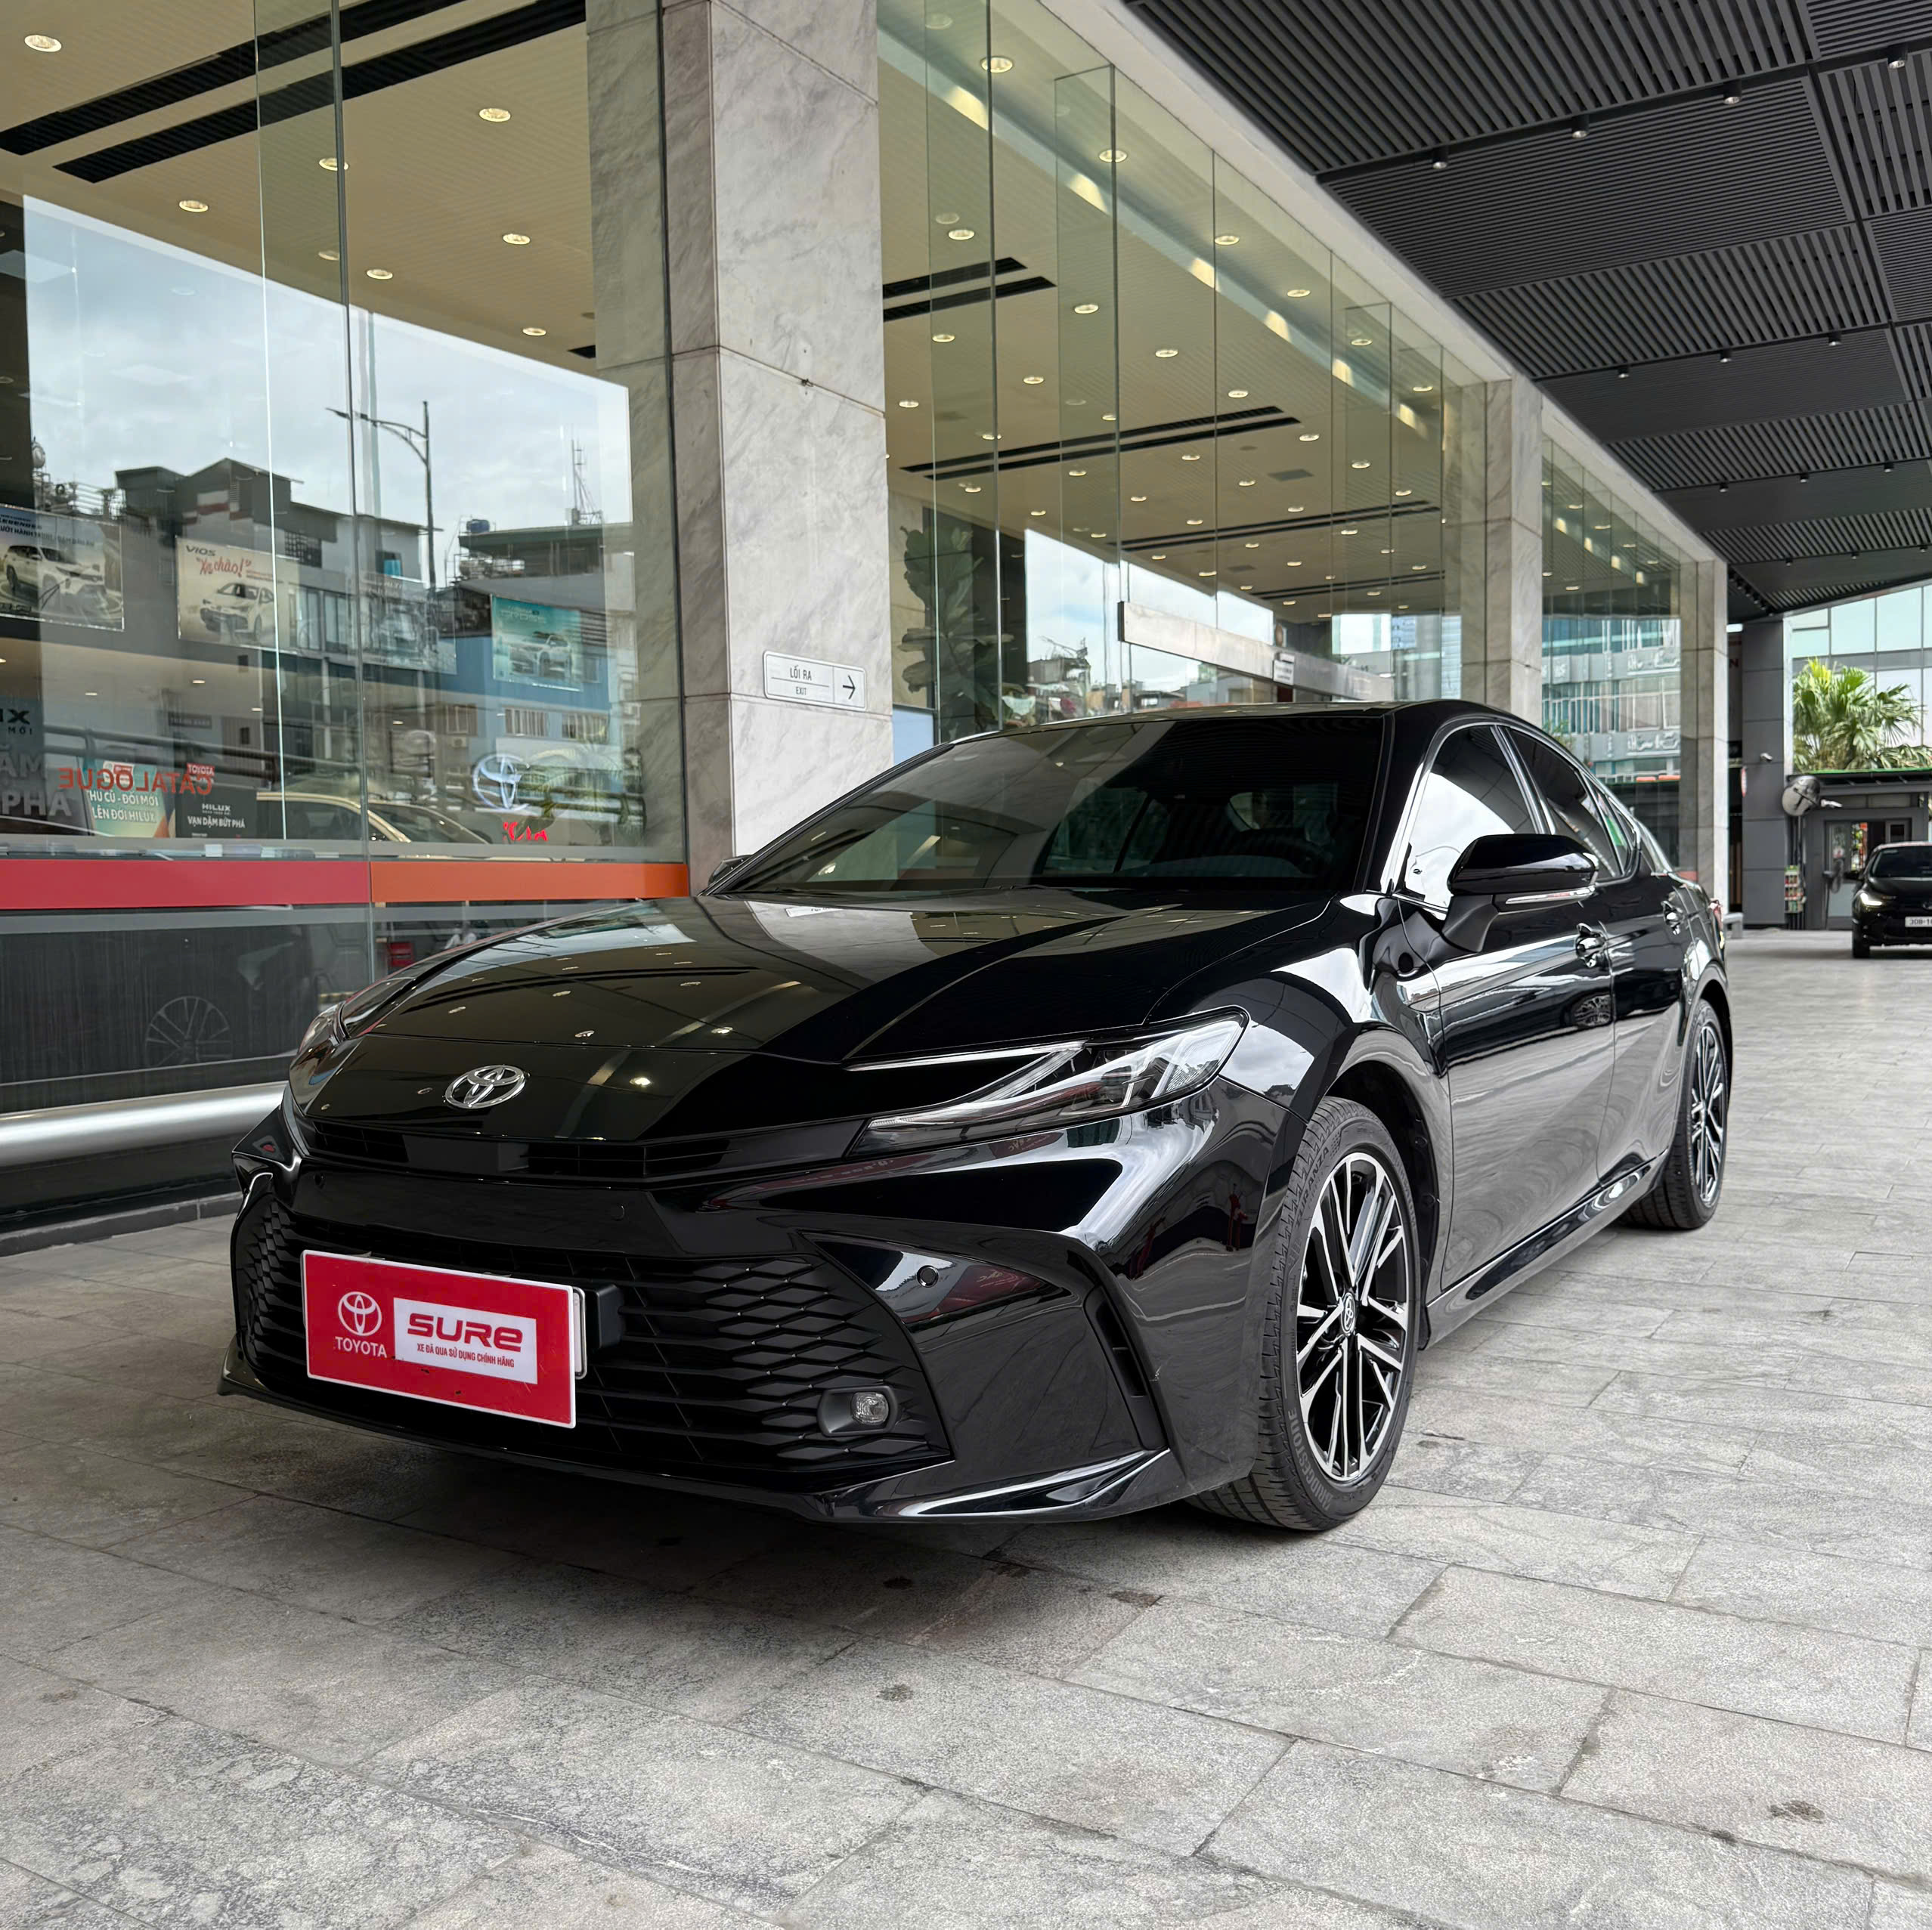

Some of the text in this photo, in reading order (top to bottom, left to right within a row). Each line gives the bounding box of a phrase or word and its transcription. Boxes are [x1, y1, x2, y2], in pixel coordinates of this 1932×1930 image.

[185, 545, 216, 556] VIOS
[803, 669, 812, 681] RA
[795, 686, 807, 695] EXIT
[0, 708, 30, 724] X
[188, 763, 215, 775] TOYOTA
[202, 803, 231, 812] HILUX
[1295, 1146, 1330, 1229] TURANZA
[335, 1335, 387, 1359] TOYOTA
[416, 1343, 515, 1368] XE ĐÃ QUA SỬ DỤNG CHÍNH HÃNG
[1287, 1406, 1334, 1511] BRIDGESTONE
